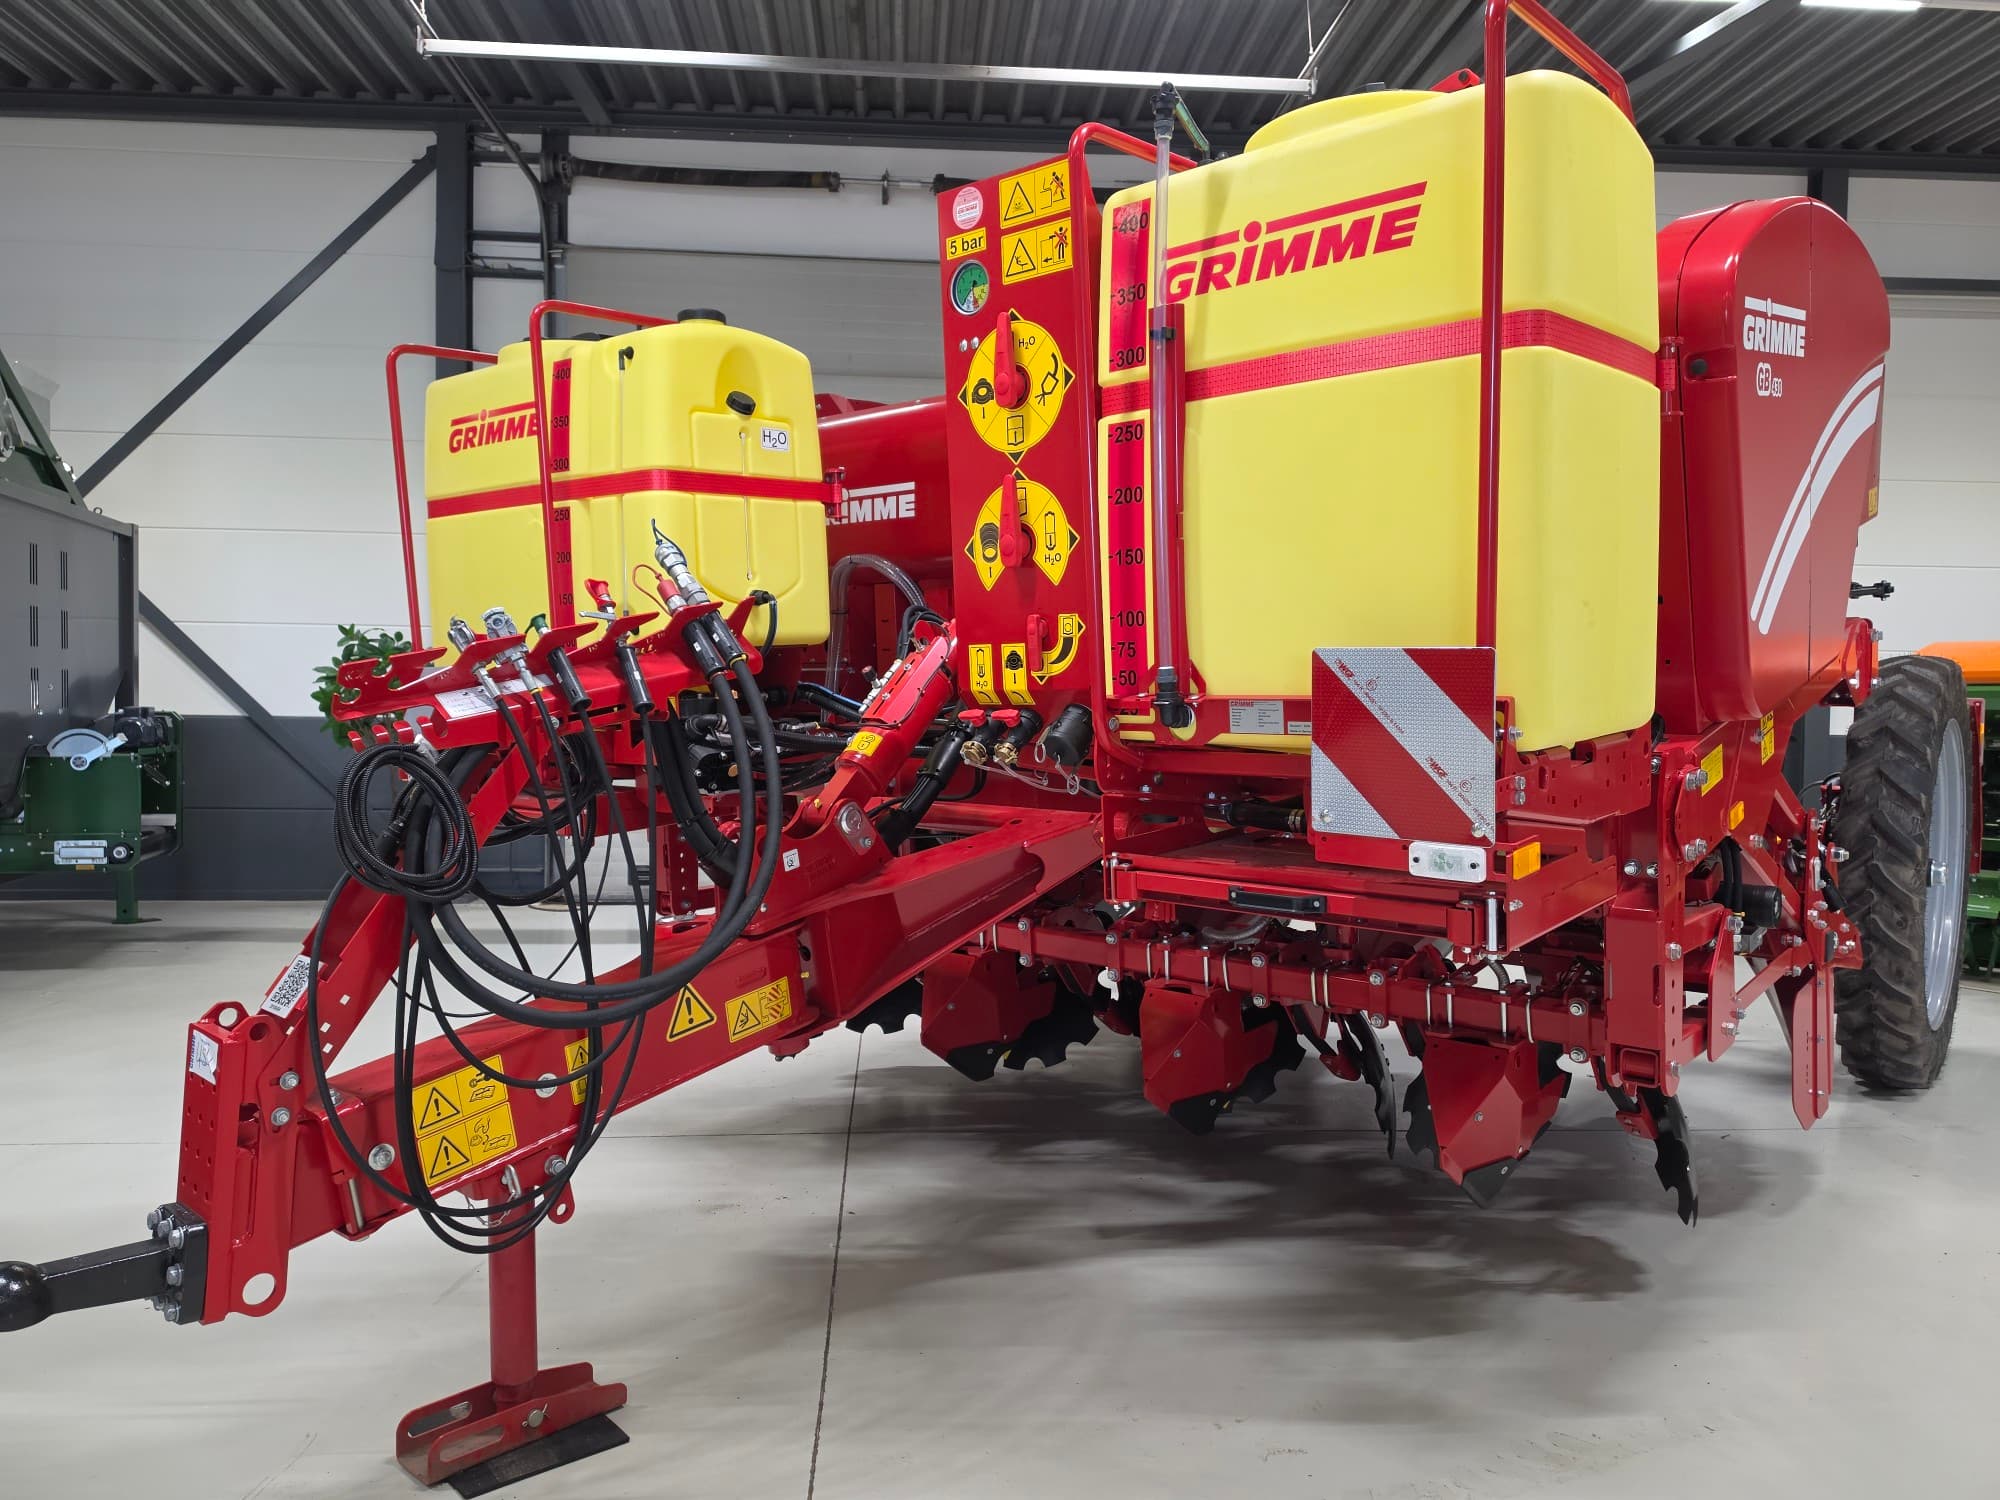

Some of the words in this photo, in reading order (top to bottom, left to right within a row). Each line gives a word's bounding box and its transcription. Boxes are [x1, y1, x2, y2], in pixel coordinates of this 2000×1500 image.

[950, 240, 957, 255] 5
[962, 236, 984, 251] bar
[1160, 203, 1422, 304] GRIMME
[1743, 298, 1806, 357] GRIMME
[1757, 362, 1771, 396] GB
